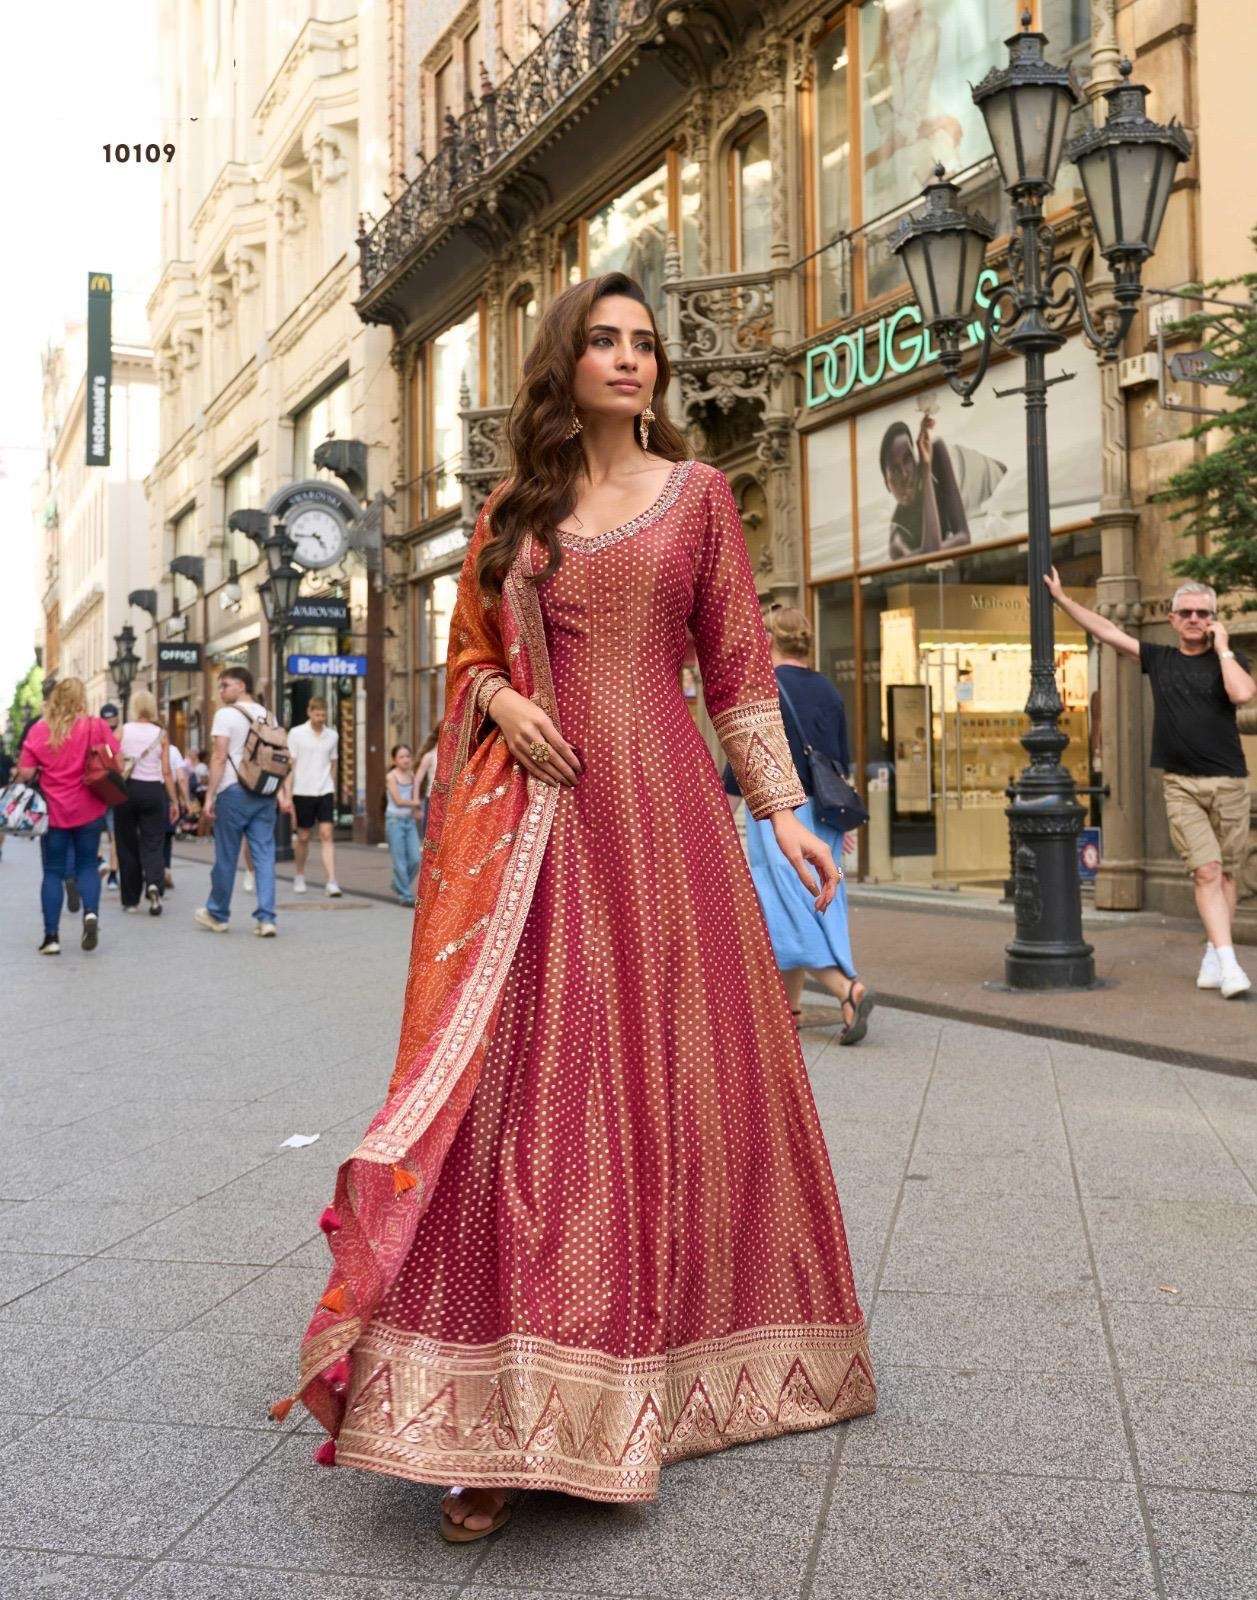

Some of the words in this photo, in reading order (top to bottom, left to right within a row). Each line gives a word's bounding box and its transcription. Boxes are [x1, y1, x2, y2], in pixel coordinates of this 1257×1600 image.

[806, 269, 1002, 408] DOUGLS
[92, 375, 106, 456] McDonald's
[290, 605, 346, 618] WAROVSKI
[160, 650, 197, 660] OFFICE
[297, 657, 357, 674] Berlitz
